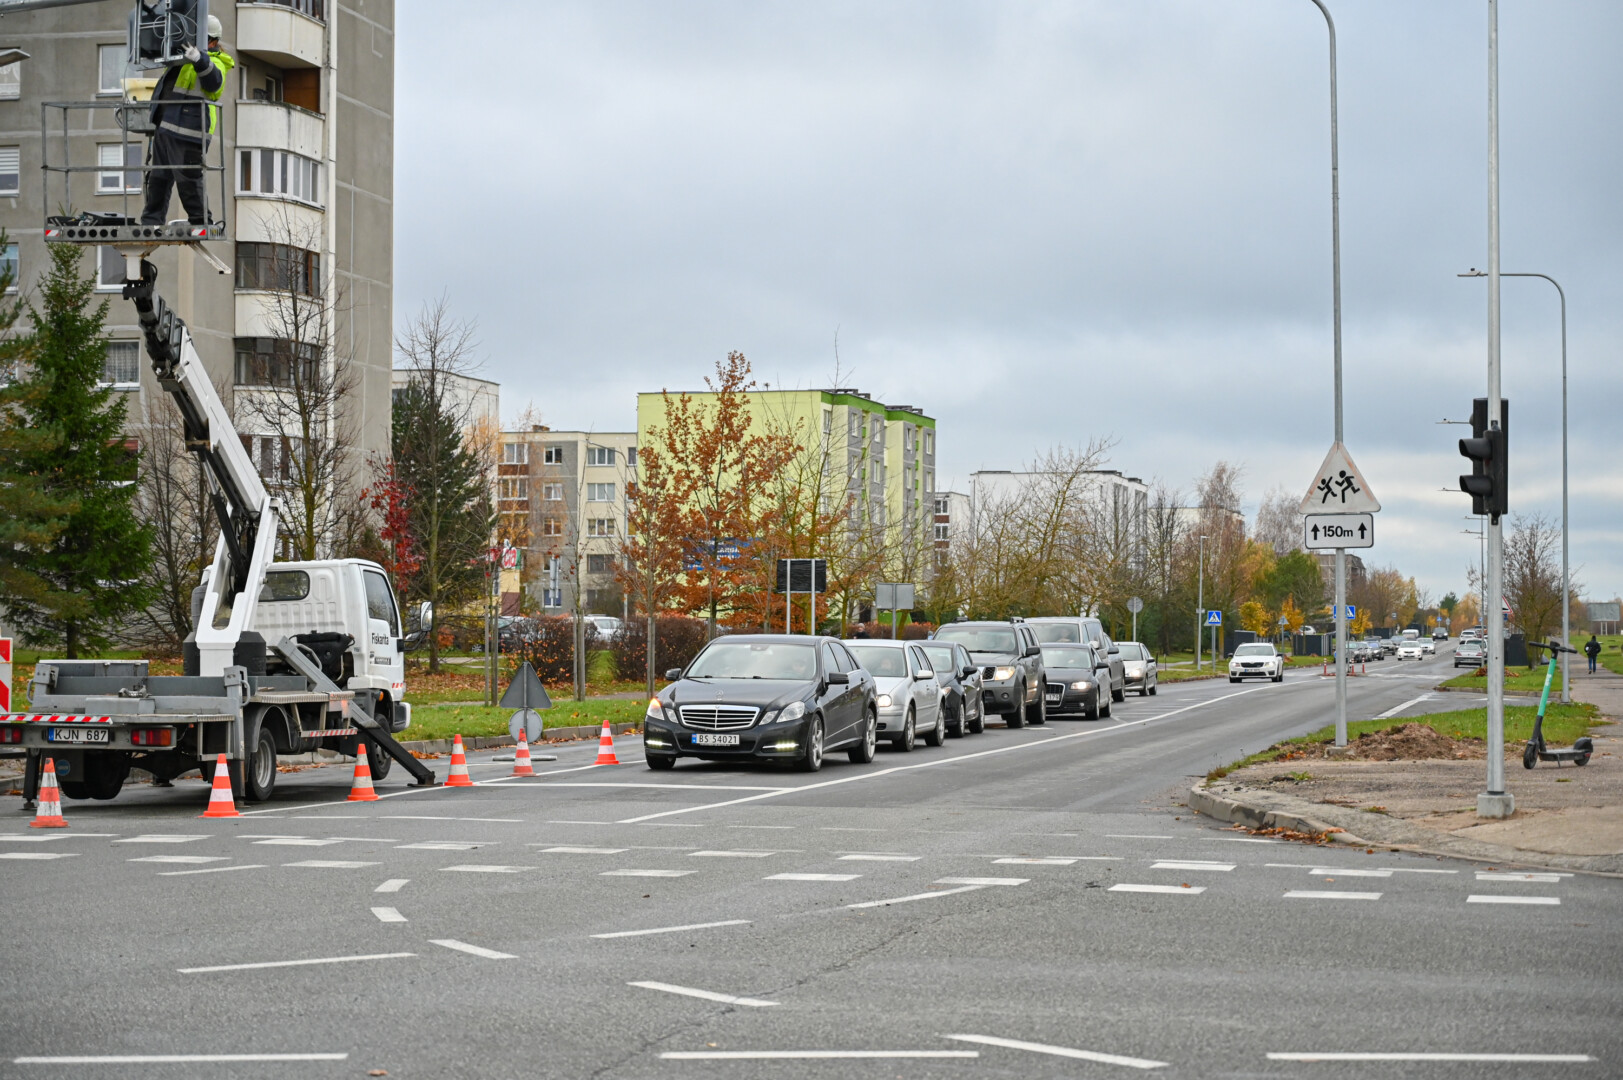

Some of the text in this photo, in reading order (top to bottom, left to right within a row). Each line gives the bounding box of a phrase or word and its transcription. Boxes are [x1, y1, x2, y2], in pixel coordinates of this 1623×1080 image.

[1322, 525, 1353, 538] 150m
[55, 729, 107, 740] KJN 687
[699, 735, 737, 744] BS 54021
